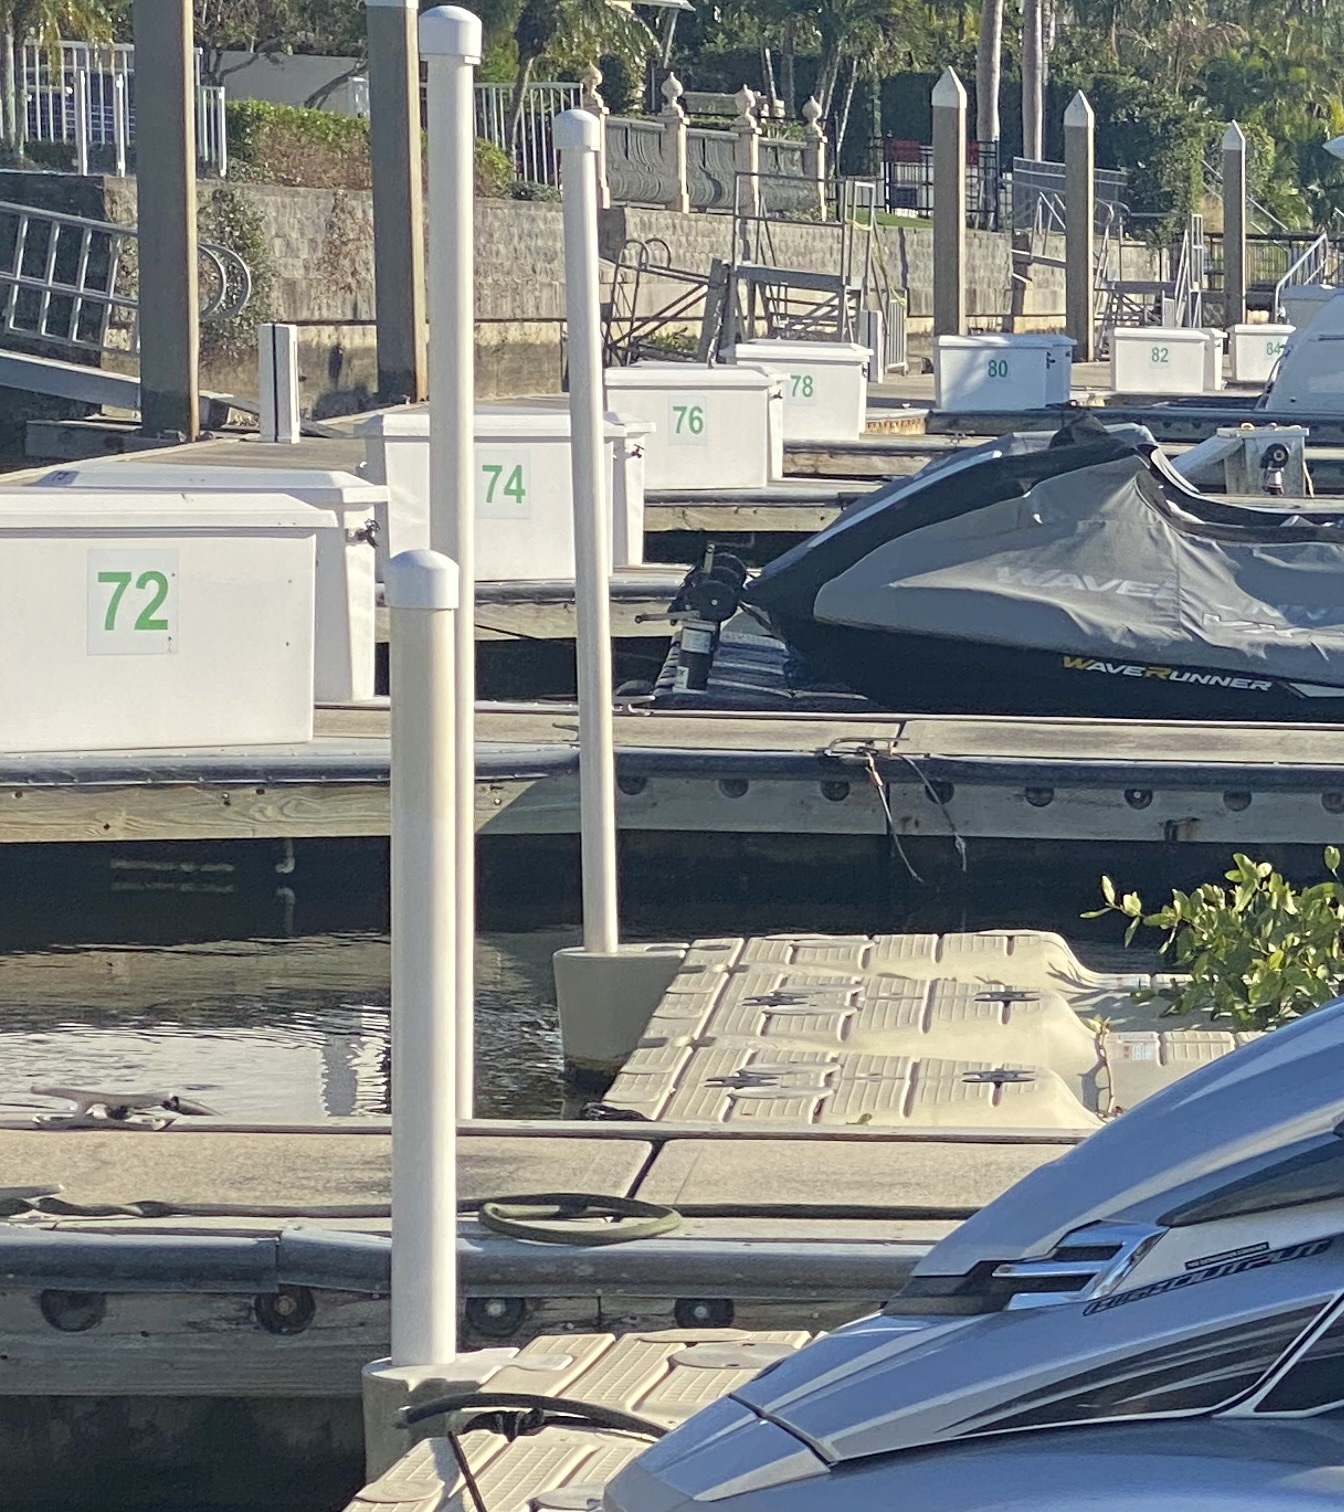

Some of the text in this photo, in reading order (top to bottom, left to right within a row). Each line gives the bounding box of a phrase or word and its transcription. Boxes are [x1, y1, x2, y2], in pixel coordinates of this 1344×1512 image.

[1151, 346, 1169, 363] 82
[1266, 341, 1281, 356] 84
[988, 359, 1008, 378] 80
[790, 375, 813, 398] 78
[672, 405, 704, 435] 76
[482, 464, 526, 504] 74
[98, 570, 169, 631] 72
